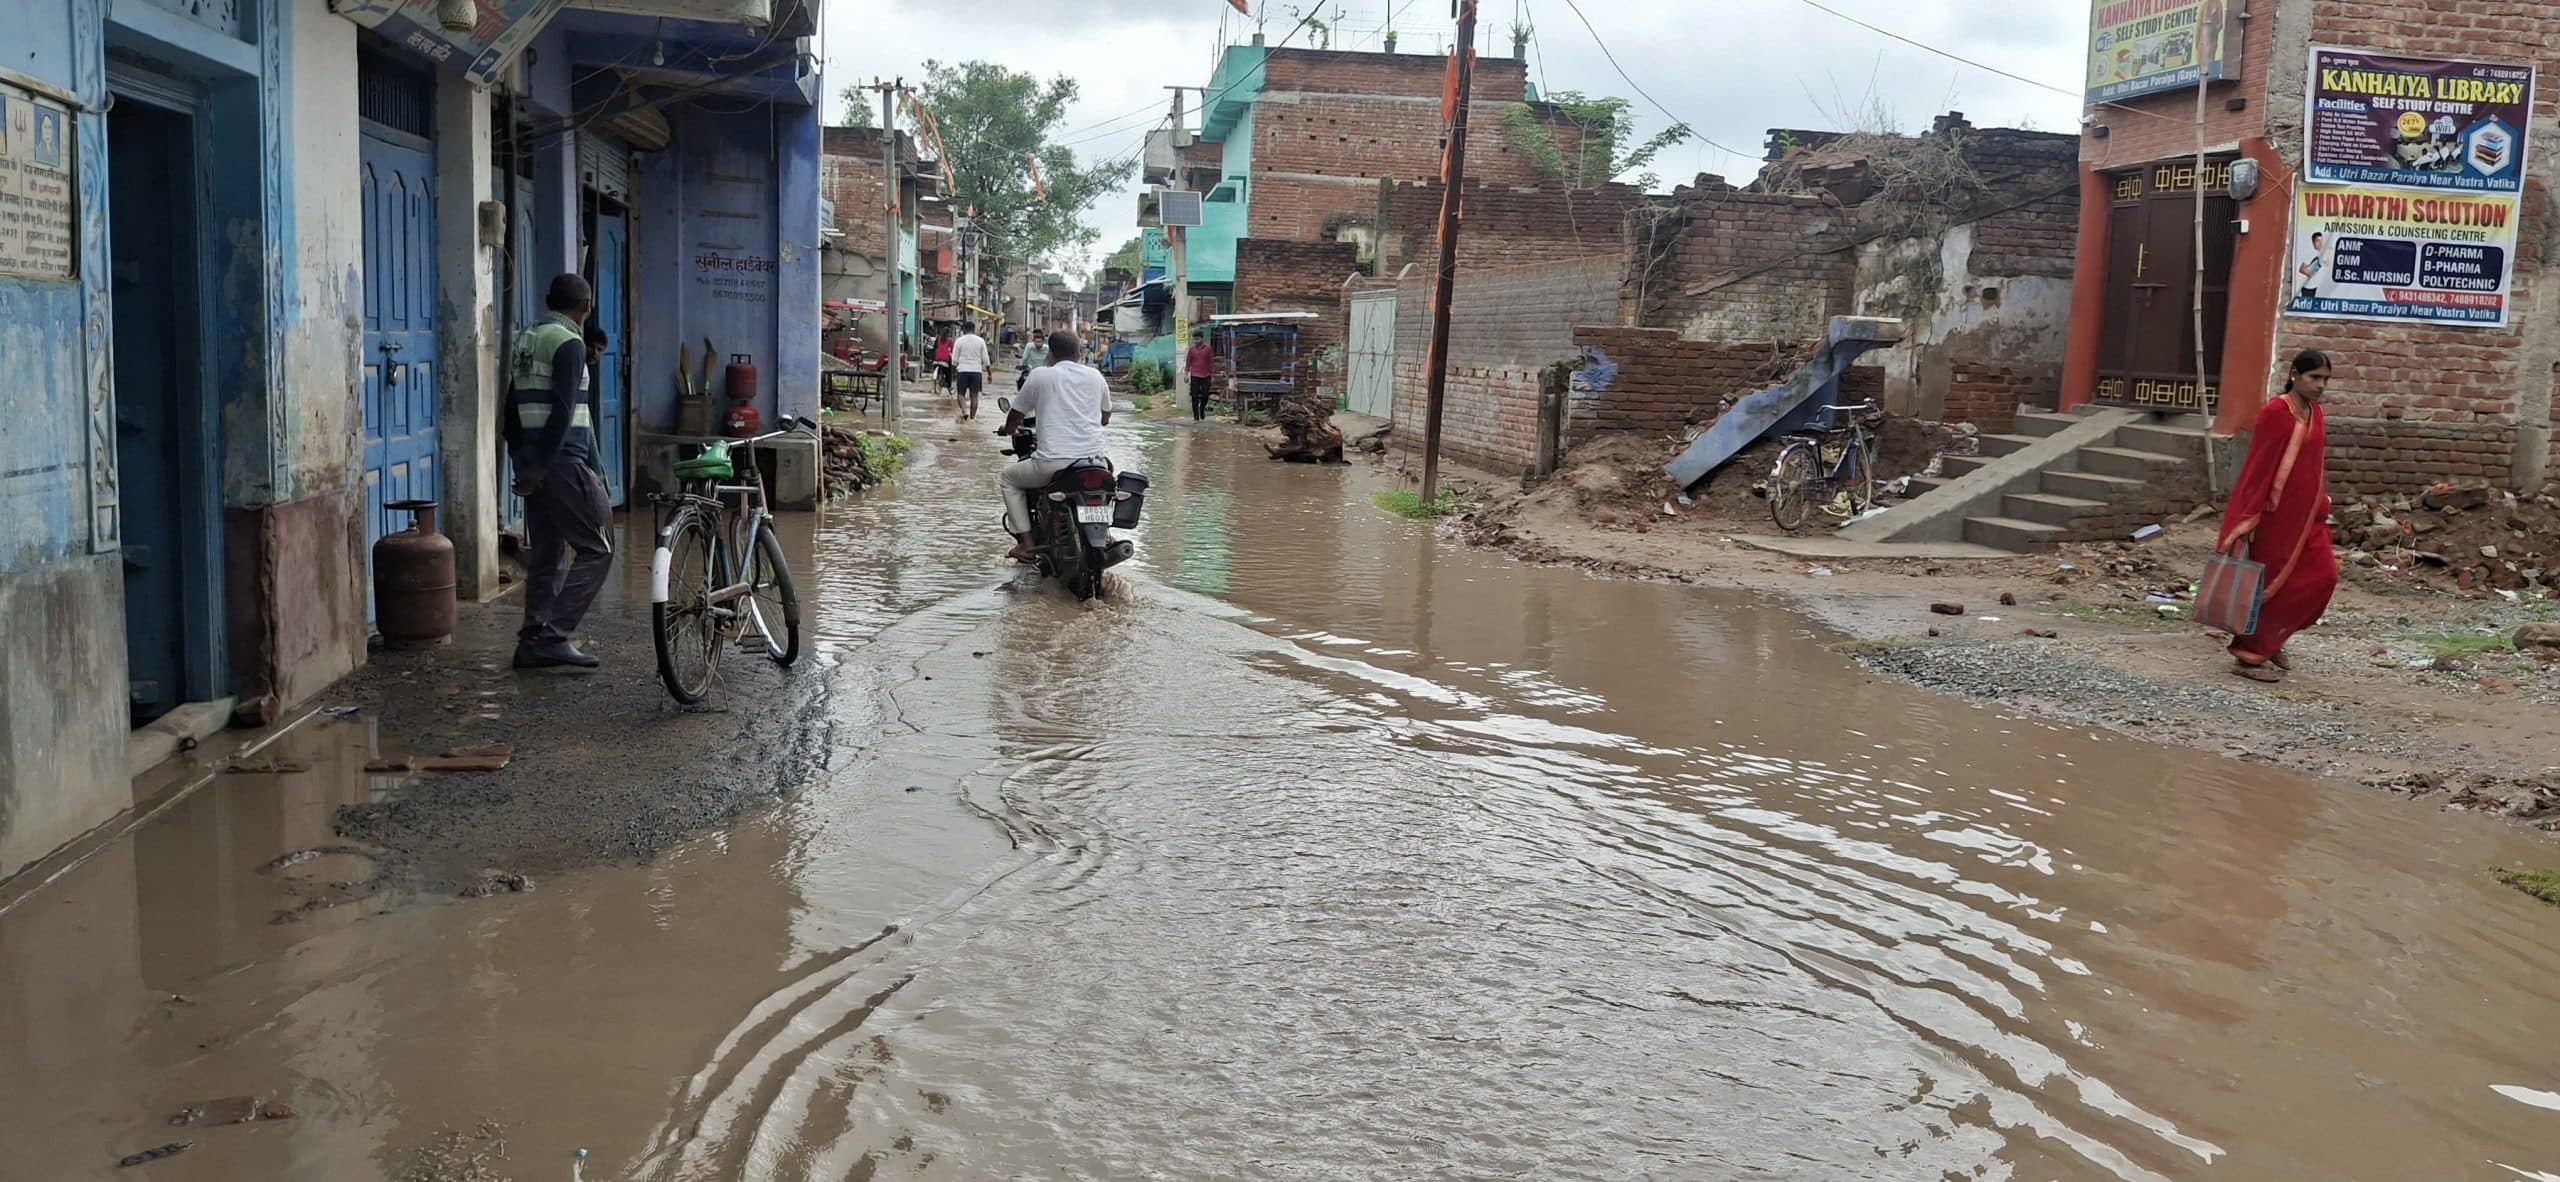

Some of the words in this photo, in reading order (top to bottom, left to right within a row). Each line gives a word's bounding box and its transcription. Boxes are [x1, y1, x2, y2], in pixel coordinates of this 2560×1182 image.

[2115, 24, 2134, 43] SELF
[2135, 16, 2163, 38] STUDY
[2165, 7, 2198, 30] CENTRE
[2322, 69, 2431, 98] KANHAIYA
[2437, 78, 2524, 104] LIBRARY
[2318, 98, 2366, 112] Facilities
[2372, 96, 2395, 109] SELF
[2397, 99, 2432, 112] STUDY
[2434, 101, 2473, 115] CENTRE
[2314, 166, 2332, 178] Add
[2340, 167, 2358, 179] Utri
[2360, 169, 2389, 181] Bazar
[2390, 171, 2427, 185] Paraiya
[2430, 173, 2453, 185] Near
[2455, 175, 2484, 188] Vastra
[2486, 177, 2516, 189] Vatika
[2304, 191, 2408, 222] VIDYARTHI
[2412, 199, 2507, 228] SOLUTION
[2324, 222, 2375, 236] ADMISSION
[2377, 225, 2384, 236] &
[2387, 225, 2448, 240] COUNSELING
[2450, 229, 2487, 242] CENTRE
[2336, 254, 2360, 267] GNM
[2425, 245, 2484, 260] D-PHARMA
[2335, 269, 2360, 281] B.Sc.
[2363, 270, 2411, 284] NURSING
[2424, 260, 2481, 274] B-PHARMA
[2422, 275, 2496, 290] POLYTECHNIC
[2292, 298, 2313, 310] Add
[2320, 299, 2338, 312] Utri
[2341, 301, 2369, 313] Bazar
[2371, 302, 2408, 316] Paraiya
[2410, 304, 2434, 316] Near
[2436, 305, 2466, 319] Vastra
[2468, 307, 2496, 320] Vatika
